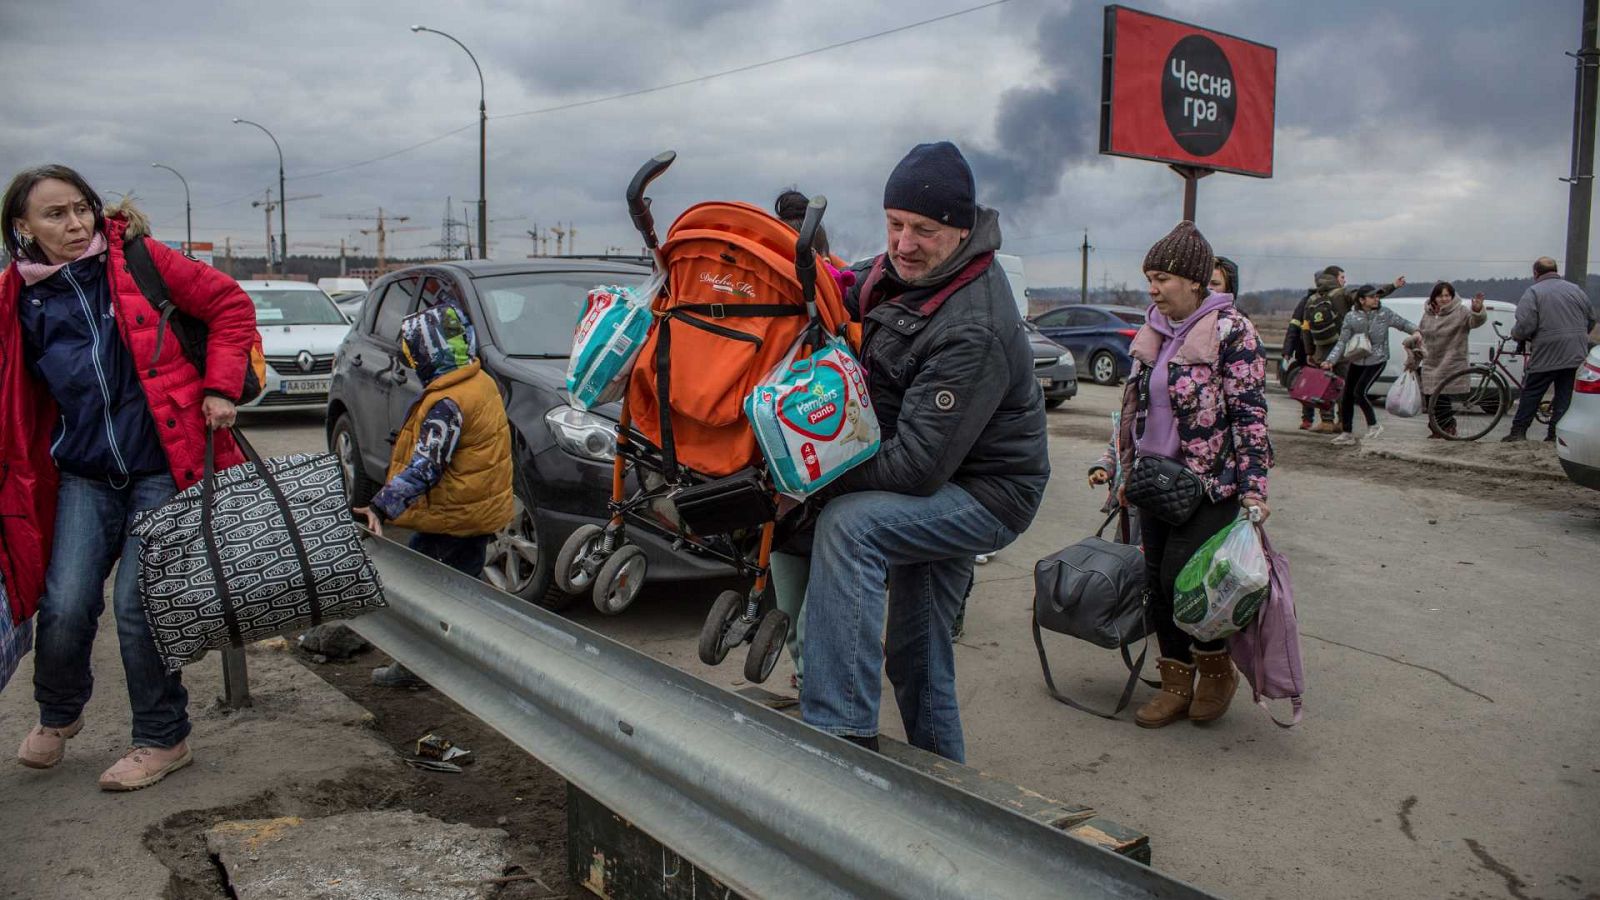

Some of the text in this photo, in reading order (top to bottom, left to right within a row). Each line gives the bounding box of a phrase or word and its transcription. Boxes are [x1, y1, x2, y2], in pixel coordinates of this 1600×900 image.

[1171, 58, 1232, 99] Чесна
[1183, 97, 1217, 127] гра
[796, 389, 838, 416] Pampers
[810, 404, 835, 424] pants
[220, 497, 252, 510] DECADA
[229, 524, 264, 538] DECADA
[220, 547, 246, 560] DECAD
[240, 553, 274, 568] DECADA
[310, 548, 345, 562] DECADA
[169, 559, 203, 573] DECADA
[228, 577, 256, 590] DECAD
[319, 576, 354, 591] DECADA
[174, 590, 211, 605] DECADA
[250, 584, 284, 599] DECADA
[159, 612, 194, 624] DECADA
[186, 620, 220, 635] DECADA
